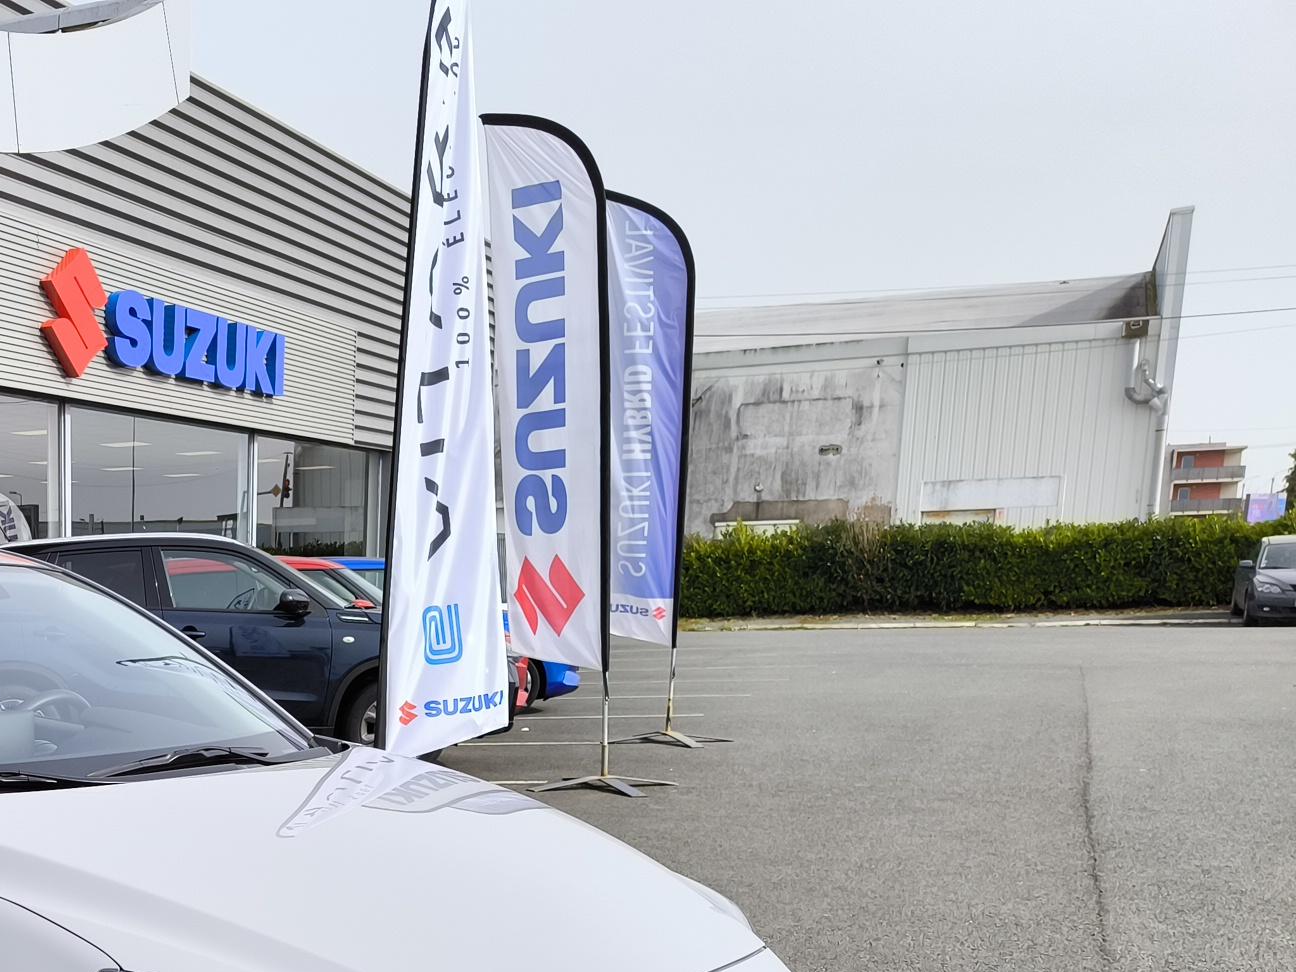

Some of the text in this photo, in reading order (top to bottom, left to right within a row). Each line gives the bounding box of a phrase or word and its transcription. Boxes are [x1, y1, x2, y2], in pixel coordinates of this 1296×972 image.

[105, 289, 286, 397] SUZUKI
[452, 275, 472, 369] 100%
[423, 690, 504, 718] SUZUKI
